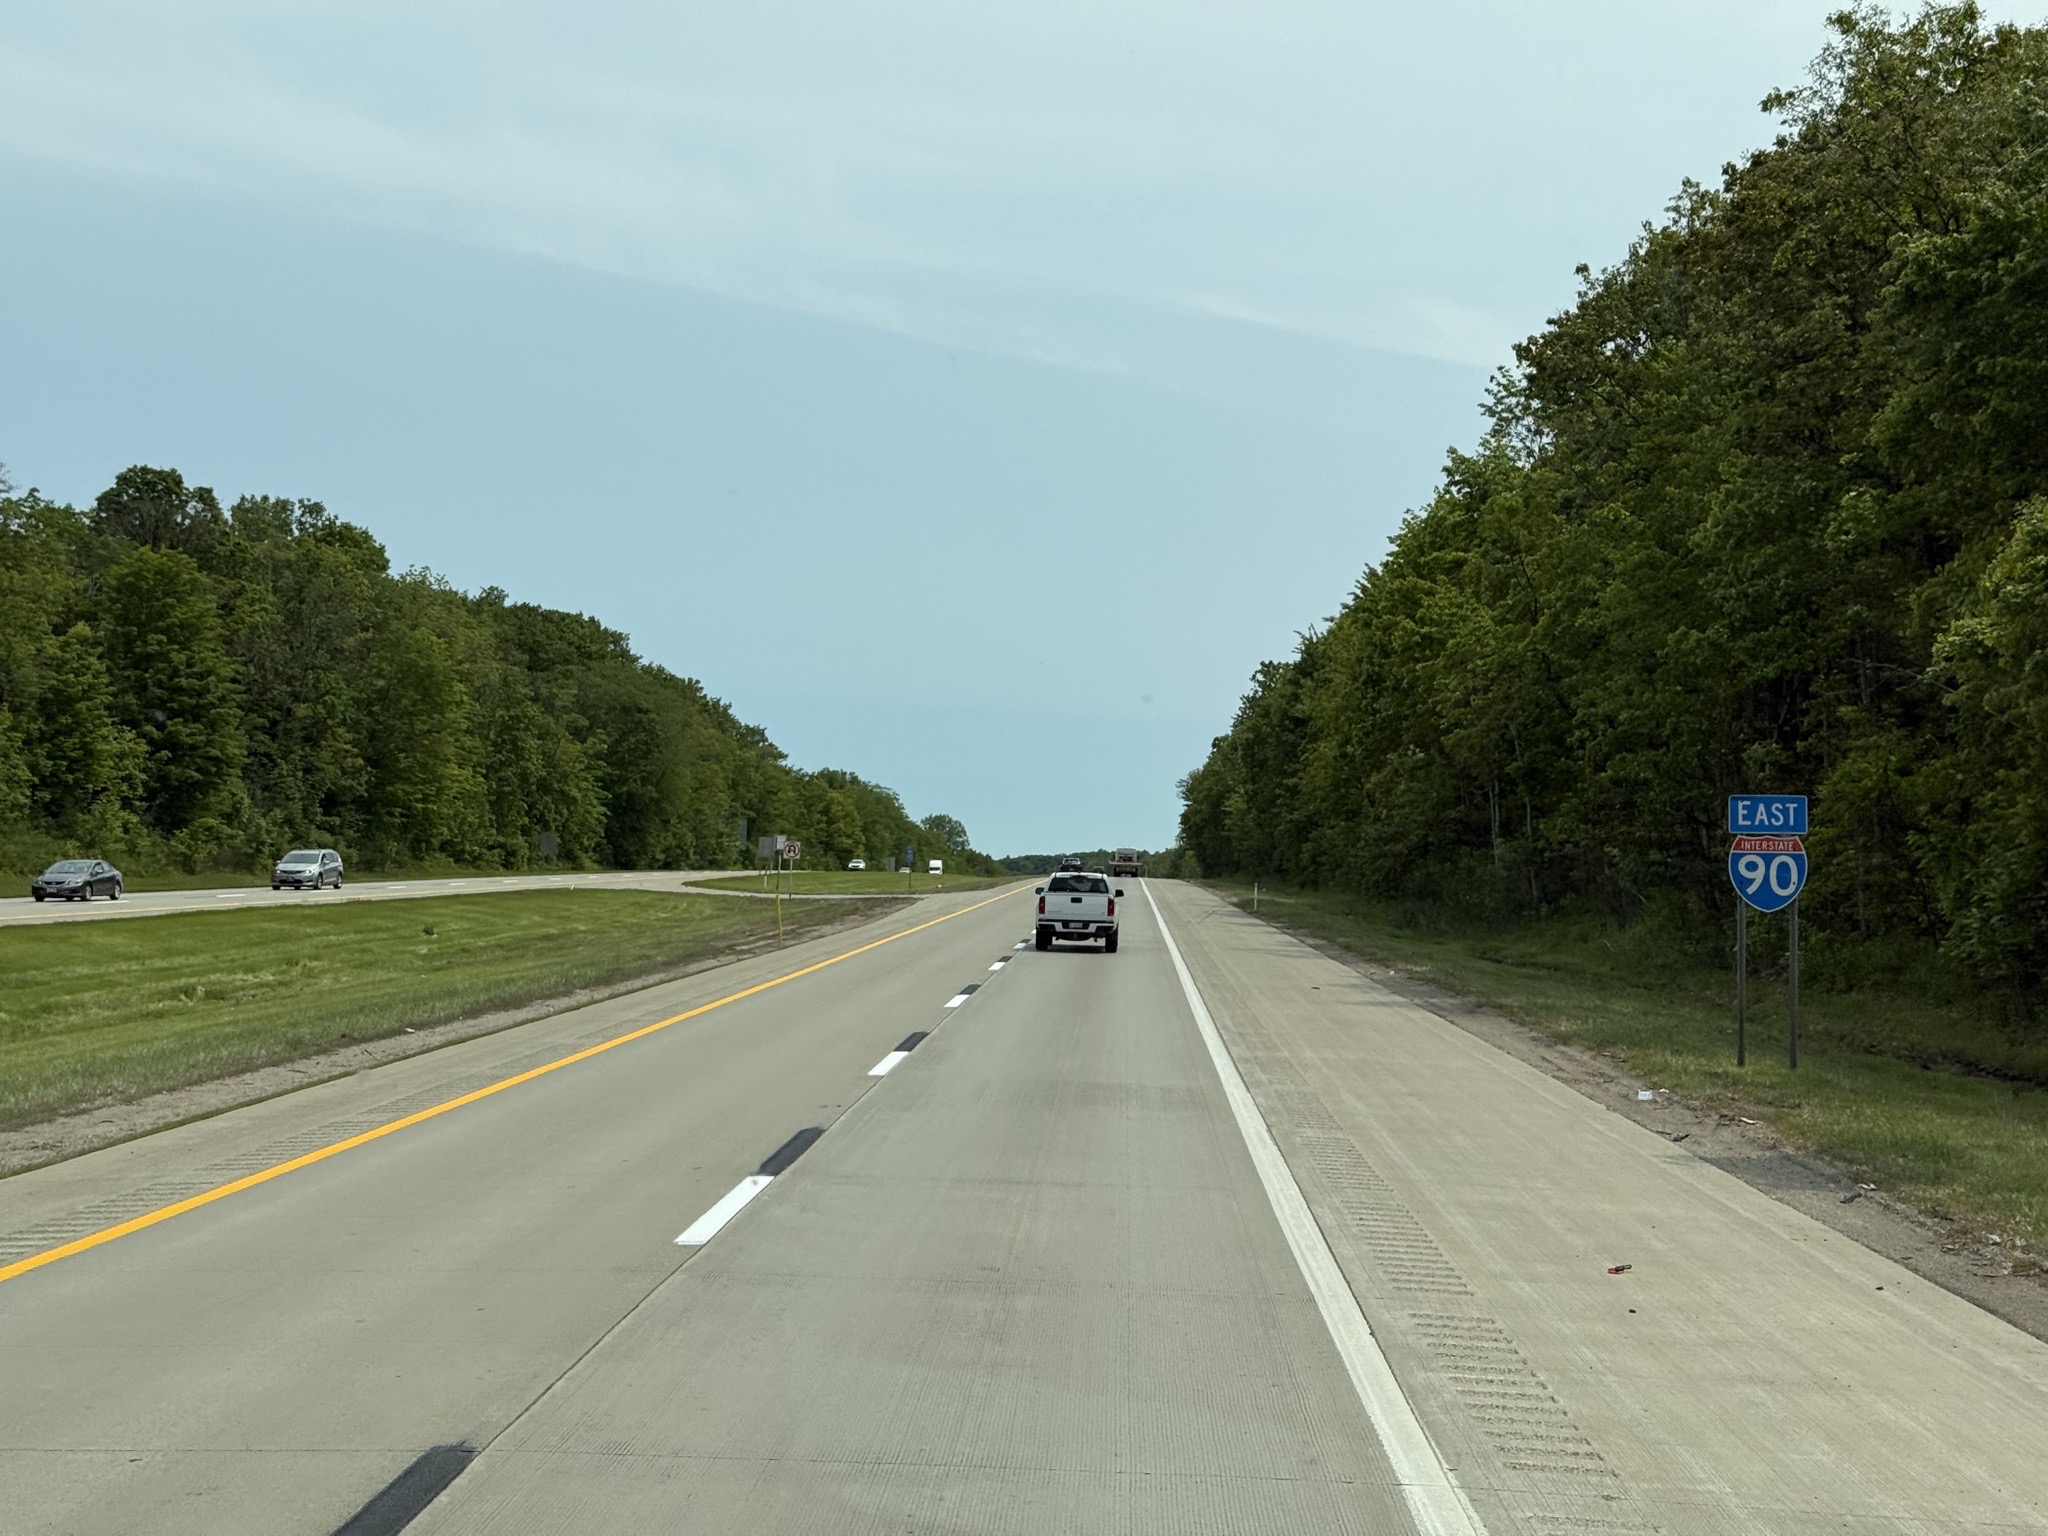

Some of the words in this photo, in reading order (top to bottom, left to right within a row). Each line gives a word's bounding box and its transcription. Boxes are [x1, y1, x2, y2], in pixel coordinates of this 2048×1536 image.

[1738, 801, 1798, 826] EAST
[1740, 841, 1793, 851] INTERSTATE
[1738, 855, 1798, 896] 90
